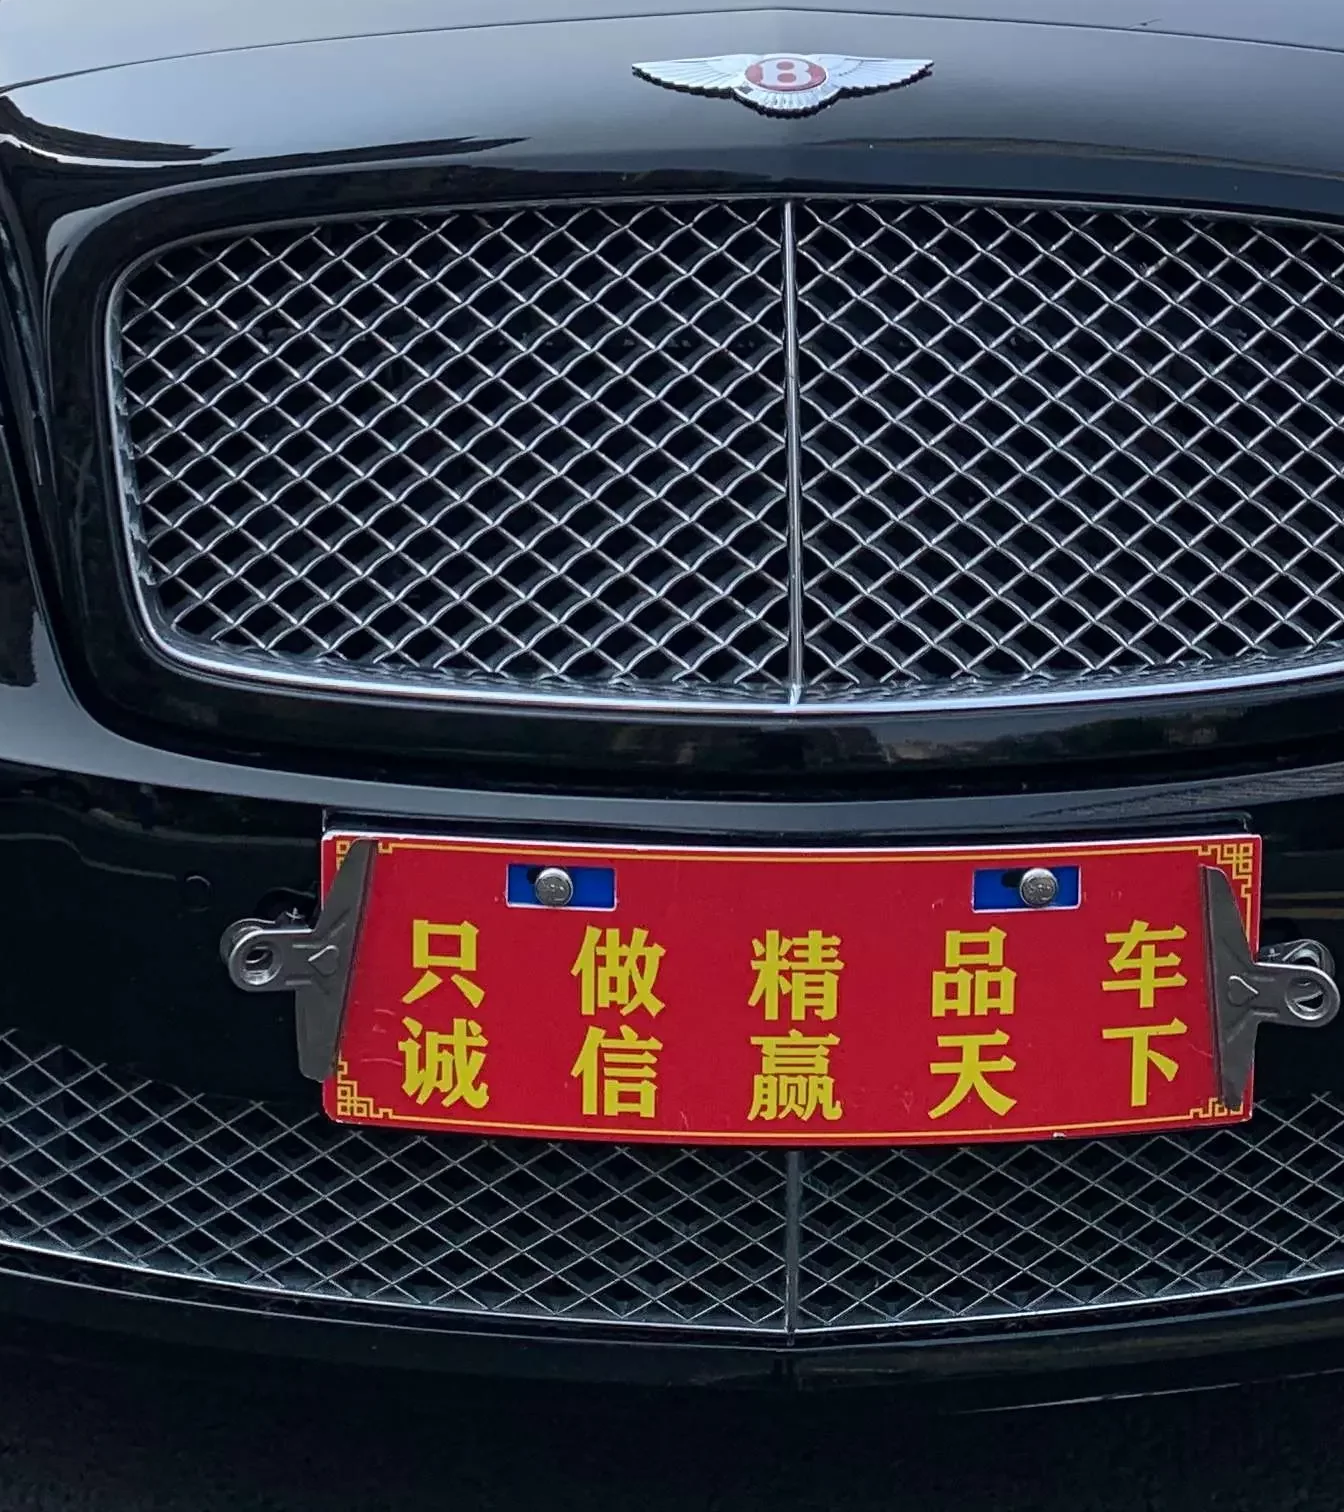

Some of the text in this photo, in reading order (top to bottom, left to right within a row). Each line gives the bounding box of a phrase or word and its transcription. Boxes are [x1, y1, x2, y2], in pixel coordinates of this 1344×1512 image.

[759, 58, 813, 90] B
[403, 920, 1188, 1021] 只做精品车
[398, 1017, 1188, 1121] 诚信赢天下
